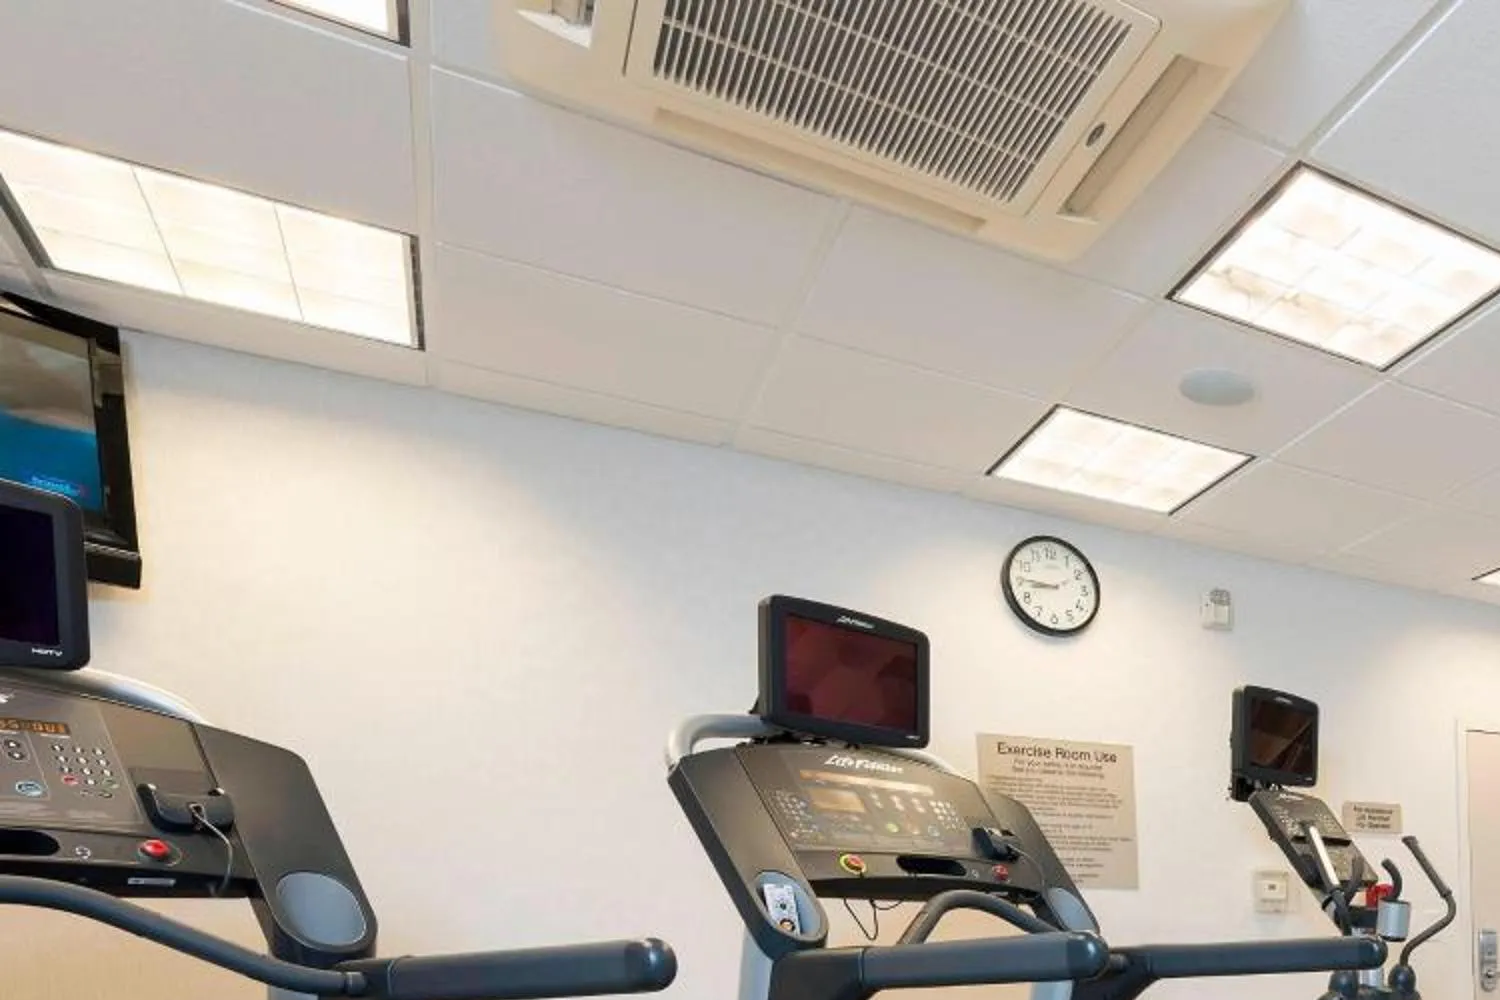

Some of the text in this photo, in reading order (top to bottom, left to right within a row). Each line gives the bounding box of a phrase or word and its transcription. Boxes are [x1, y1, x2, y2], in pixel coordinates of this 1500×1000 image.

[996, 742, 1117, 763] Exercise Room Use
